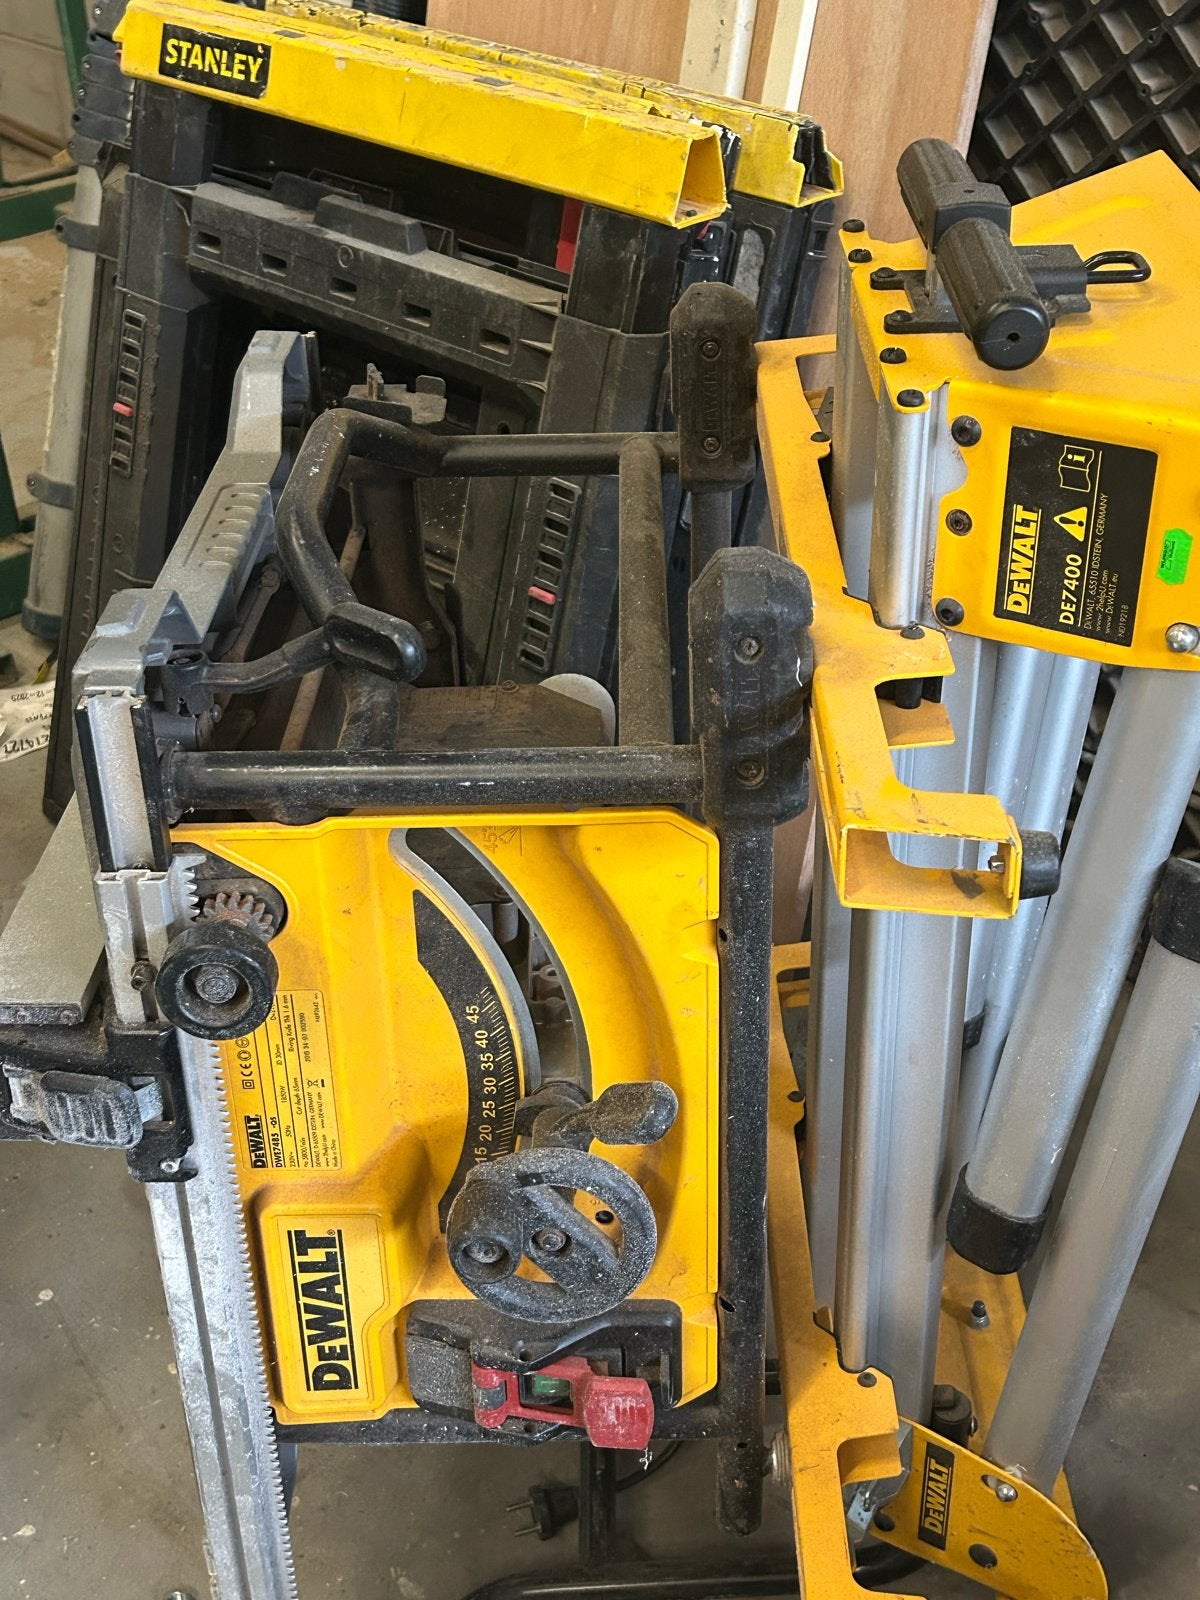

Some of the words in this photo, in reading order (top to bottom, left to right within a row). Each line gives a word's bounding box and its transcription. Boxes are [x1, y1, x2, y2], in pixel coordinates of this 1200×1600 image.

[165, 38, 263, 83] STANLEY
[1005, 504, 1041, 615] DEWALT
[1089, 571, 1099, 595] 65510
[1095, 493, 1109, 536] GERMANY
[1059, 554, 1083, 625] DE7400
[1118, 604, 1129, 637] N019218
[466, 1005, 480, 1024] 45
[475, 1030, 488, 1048] 40
[481, 1053, 494, 1071] 35
[294, 1092, 302, 1107] depth
[484, 1077, 497, 1095] 30
[483, 1100, 496, 1118] 25
[244, 1114, 268, 1168] DEWALT
[479, 1124, 492, 1141] 20
[271, 1132, 283, 1168] DWE7485
[475, 1146, 487, 1164] 15
[291, 1229, 355, 1391] DEWALT
[923, 1457, 950, 1535] DEWALT
